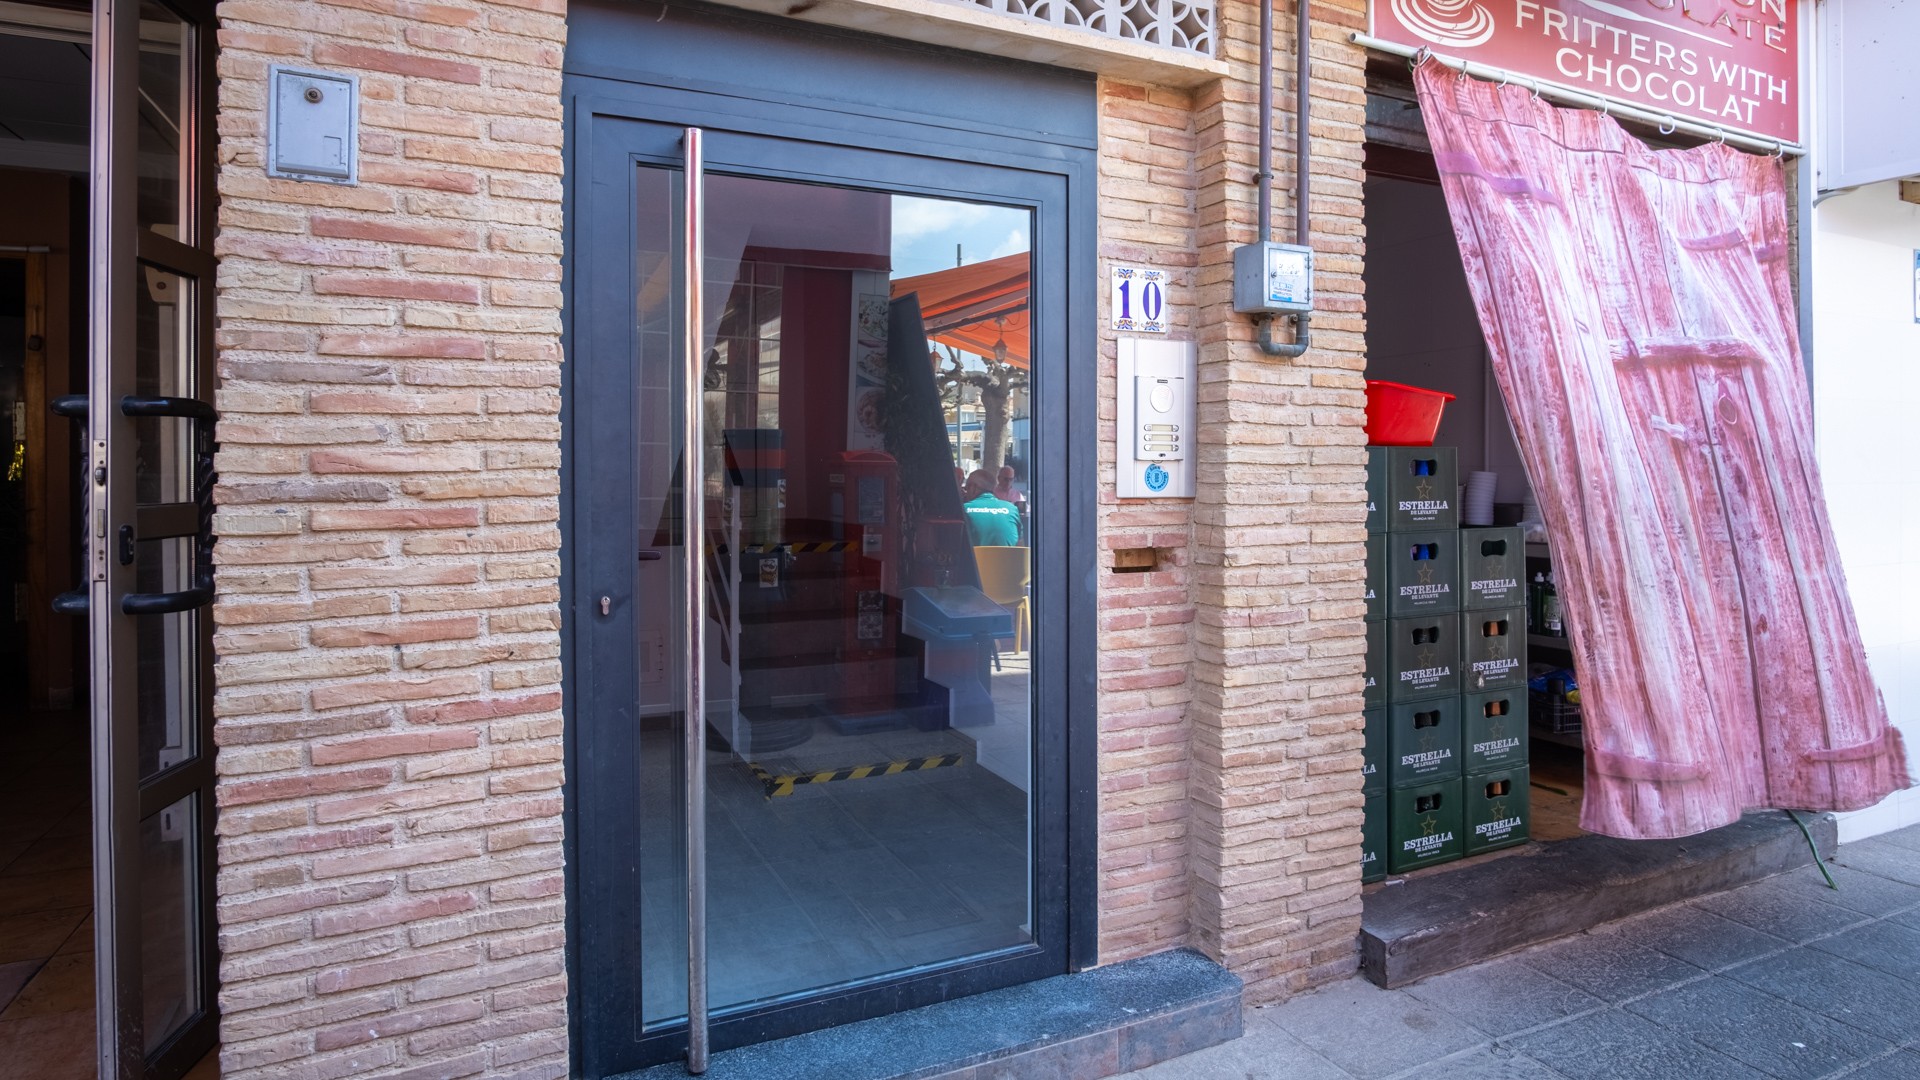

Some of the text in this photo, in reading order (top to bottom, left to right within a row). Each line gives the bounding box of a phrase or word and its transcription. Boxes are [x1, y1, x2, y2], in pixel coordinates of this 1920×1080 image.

[1514, 0, 1788, 105] FRITTERS WITH
[1555, 47, 1761, 125] CHOCOLAT
[1118, 279, 1163, 321] 10
[1399, 500, 1449, 511] ESTRELLA
[1400, 583, 1450, 596] ESTRELLA
[1471, 578, 1517, 590] ESTRELLA
[1400, 666, 1450, 681] ESTRELLA
[1472, 658, 1519, 672] ESTRELLA
[1473, 737, 1520, 753] ESTRELLA
[1401, 748, 1452, 766] ESTRELLA
[1475, 816, 1521, 835] ESTRELLA
[1403, 831, 1454, 851] ESTRELLA
